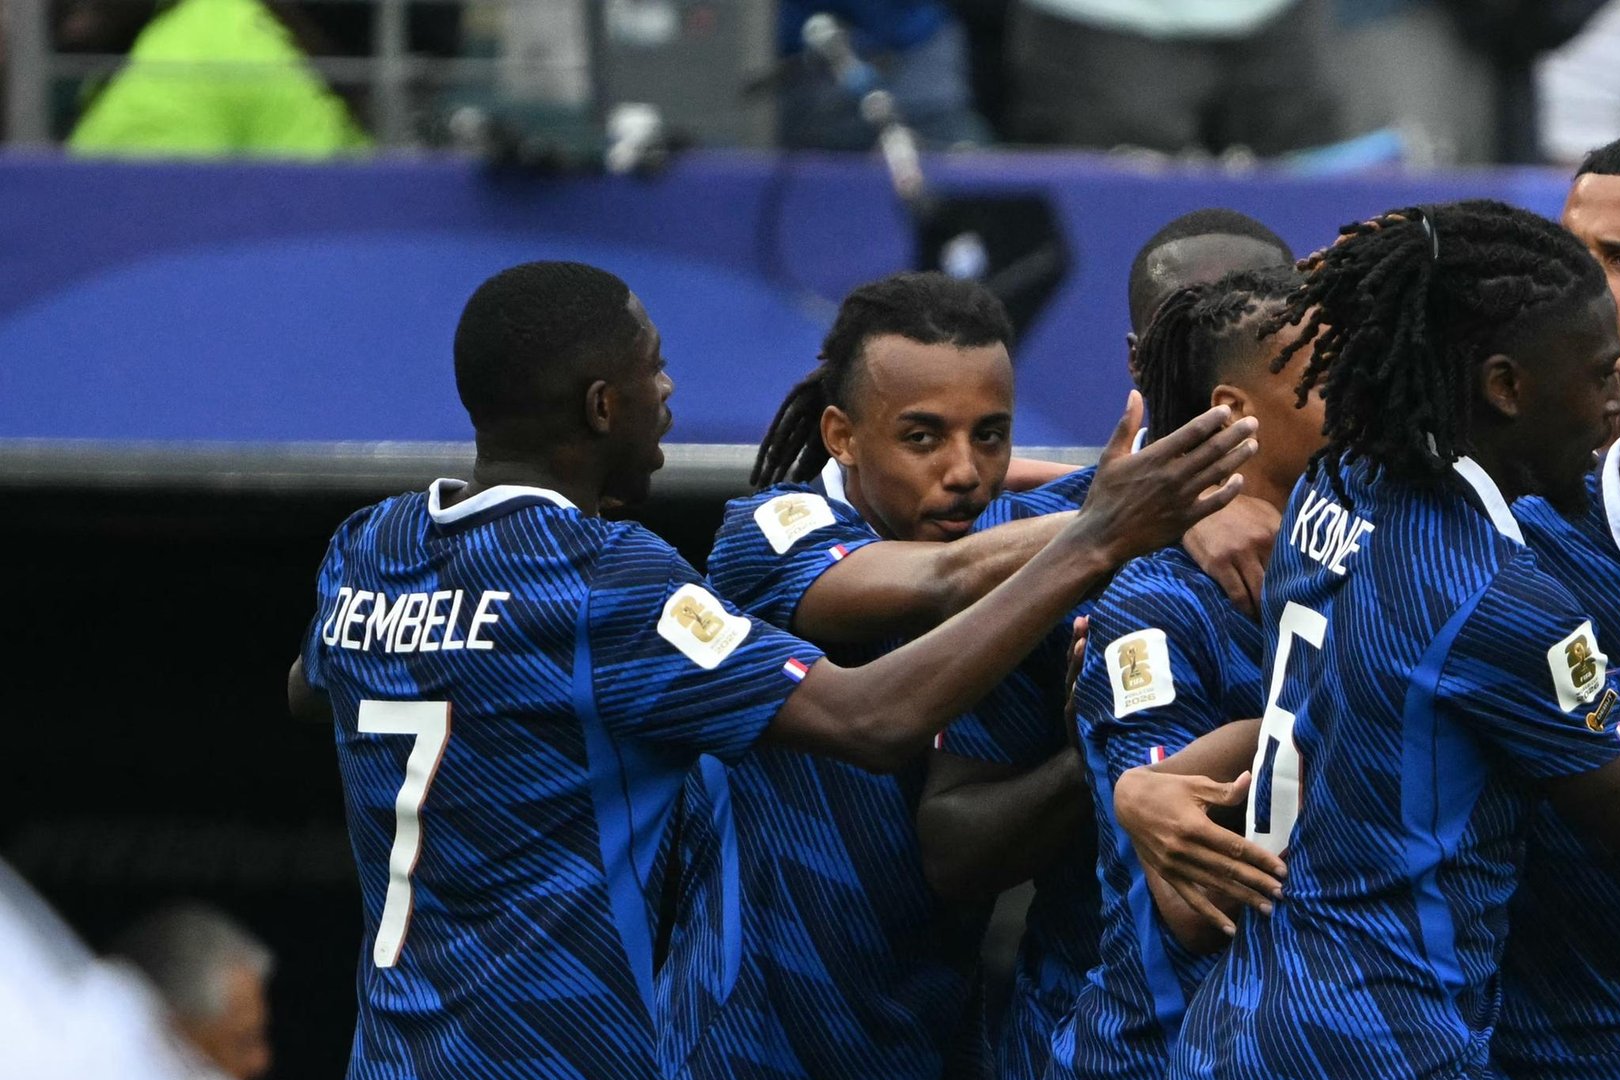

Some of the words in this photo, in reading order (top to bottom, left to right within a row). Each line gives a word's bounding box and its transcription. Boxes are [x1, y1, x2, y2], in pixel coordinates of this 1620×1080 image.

[1289, 490, 1375, 576] KONE
[322, 586, 511, 653] DEMBELE
[1125, 692, 1157, 707] 2026
[1245, 600, 1329, 864] 6
[357, 699, 451, 968] 7
